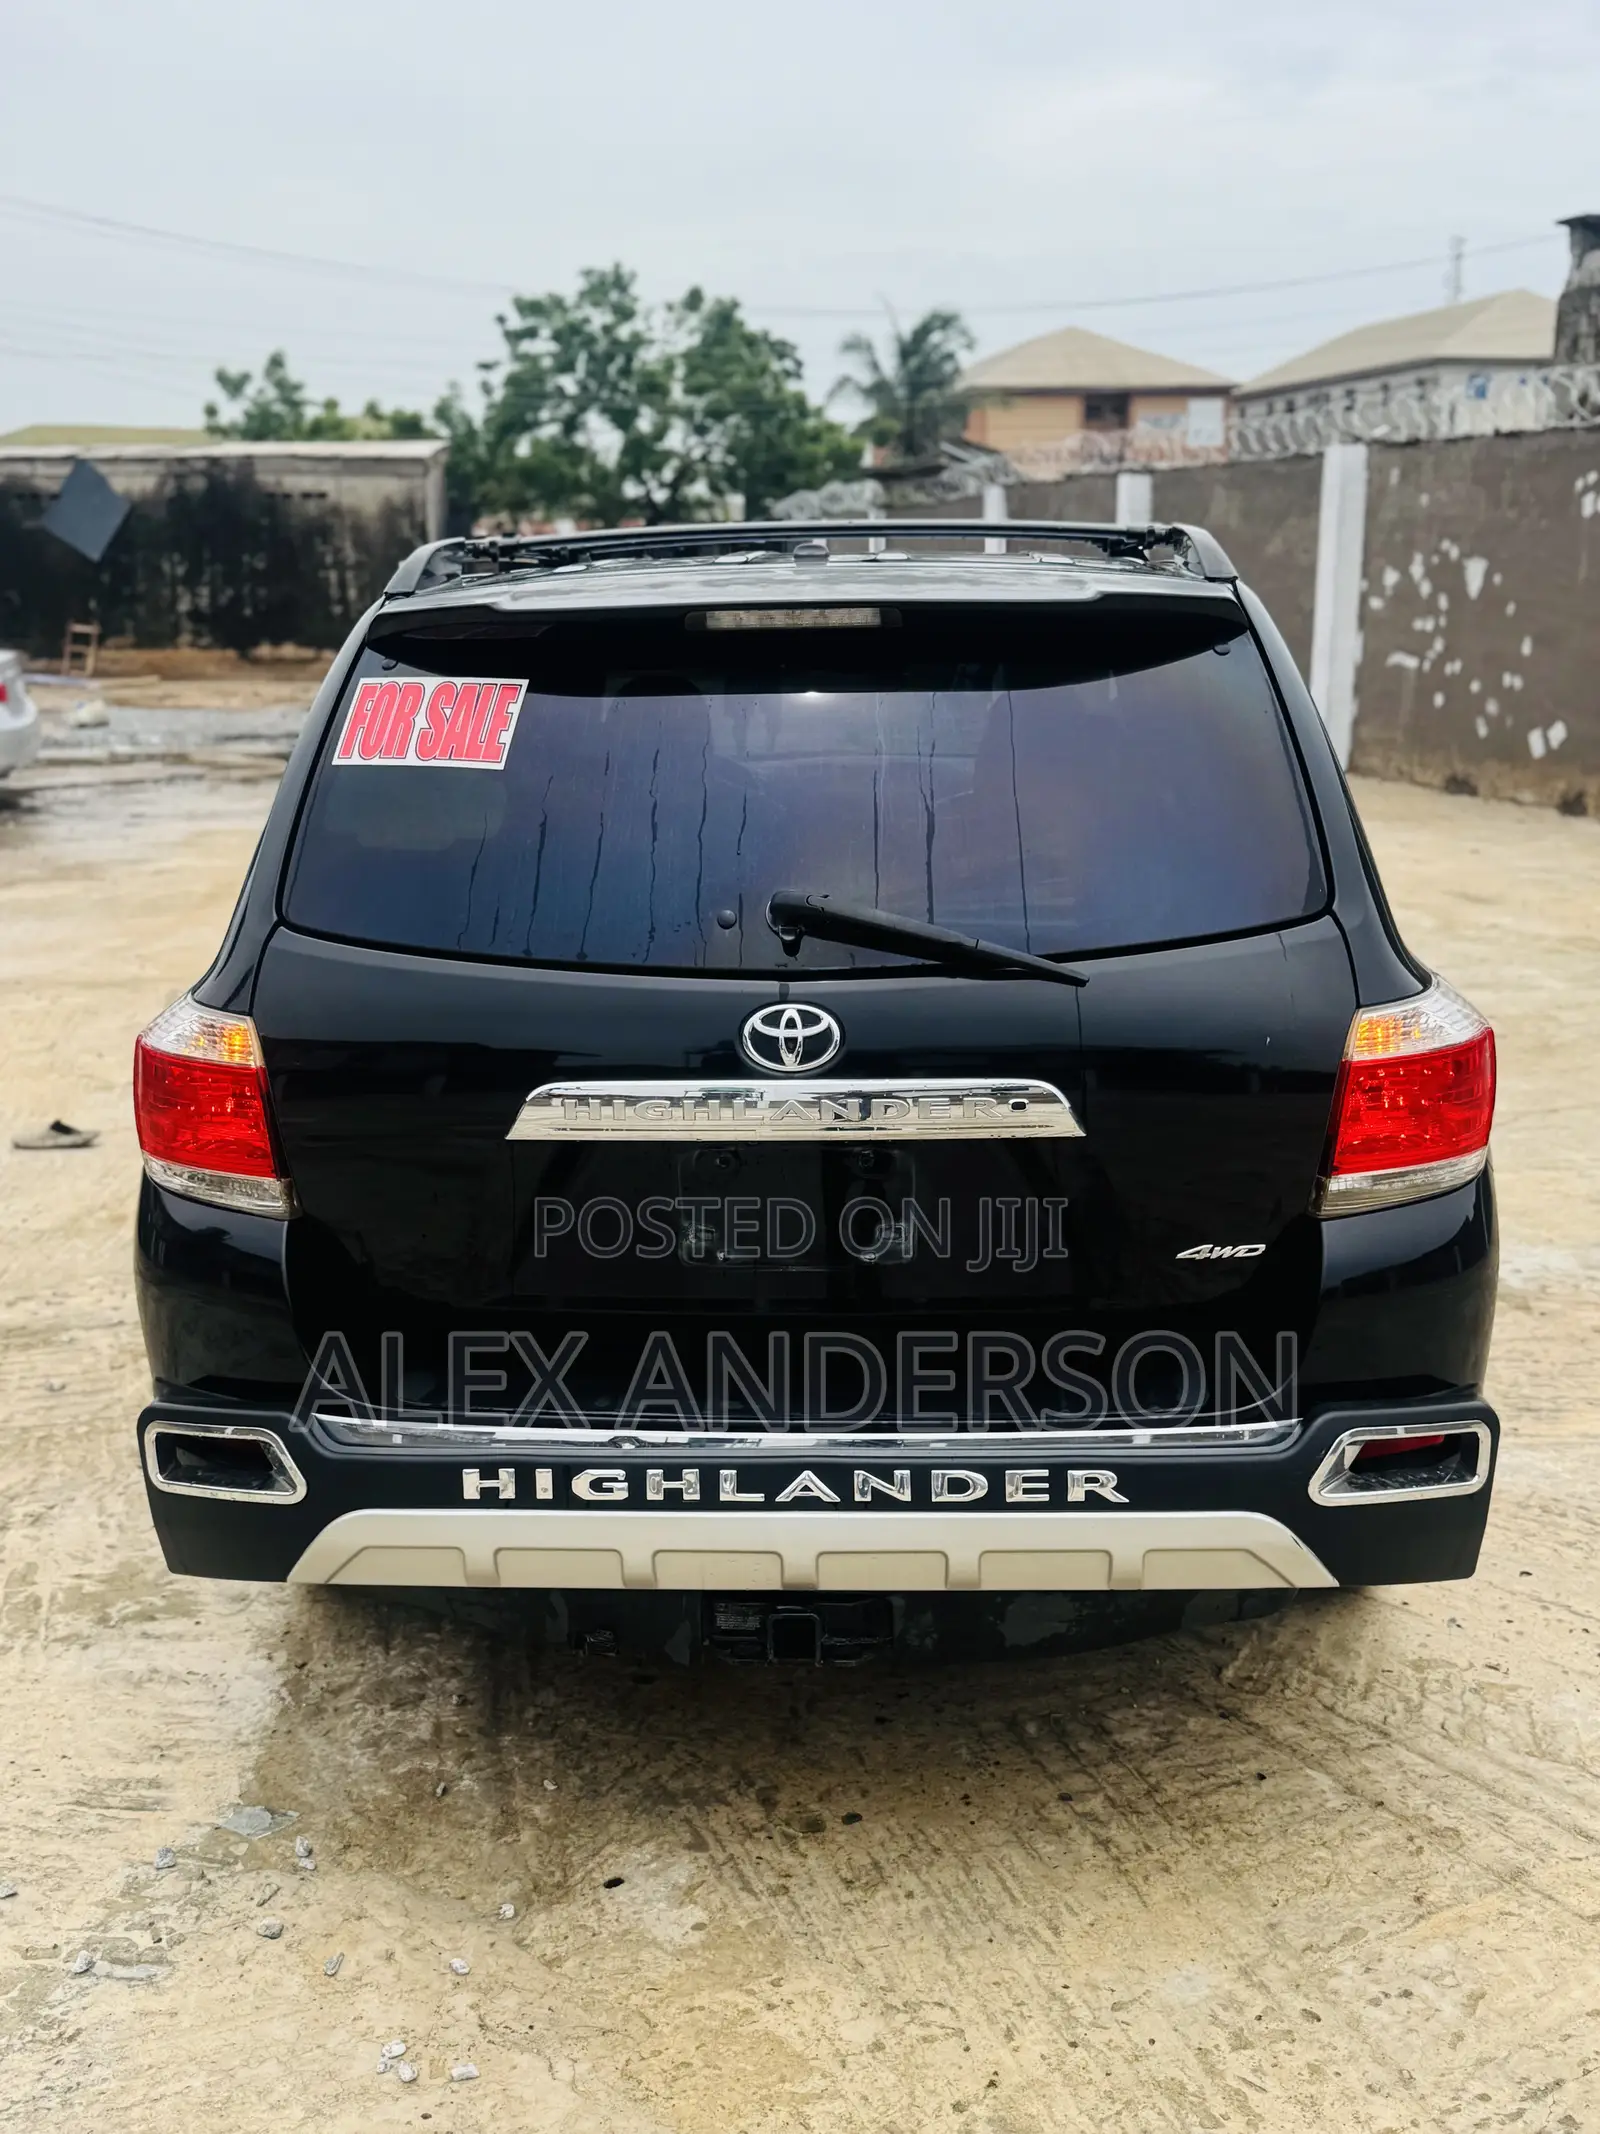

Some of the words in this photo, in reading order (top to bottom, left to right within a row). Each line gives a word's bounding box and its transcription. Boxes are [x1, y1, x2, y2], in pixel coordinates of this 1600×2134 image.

[338, 681, 425, 760] FOR
[416, 681, 521, 762] SALE
[562, 1097, 1004, 1122] HIGHLANDER
[1175, 1243, 1267, 1260] 4WD
[462, 1467, 1130, 1504] HIGHLANDER
